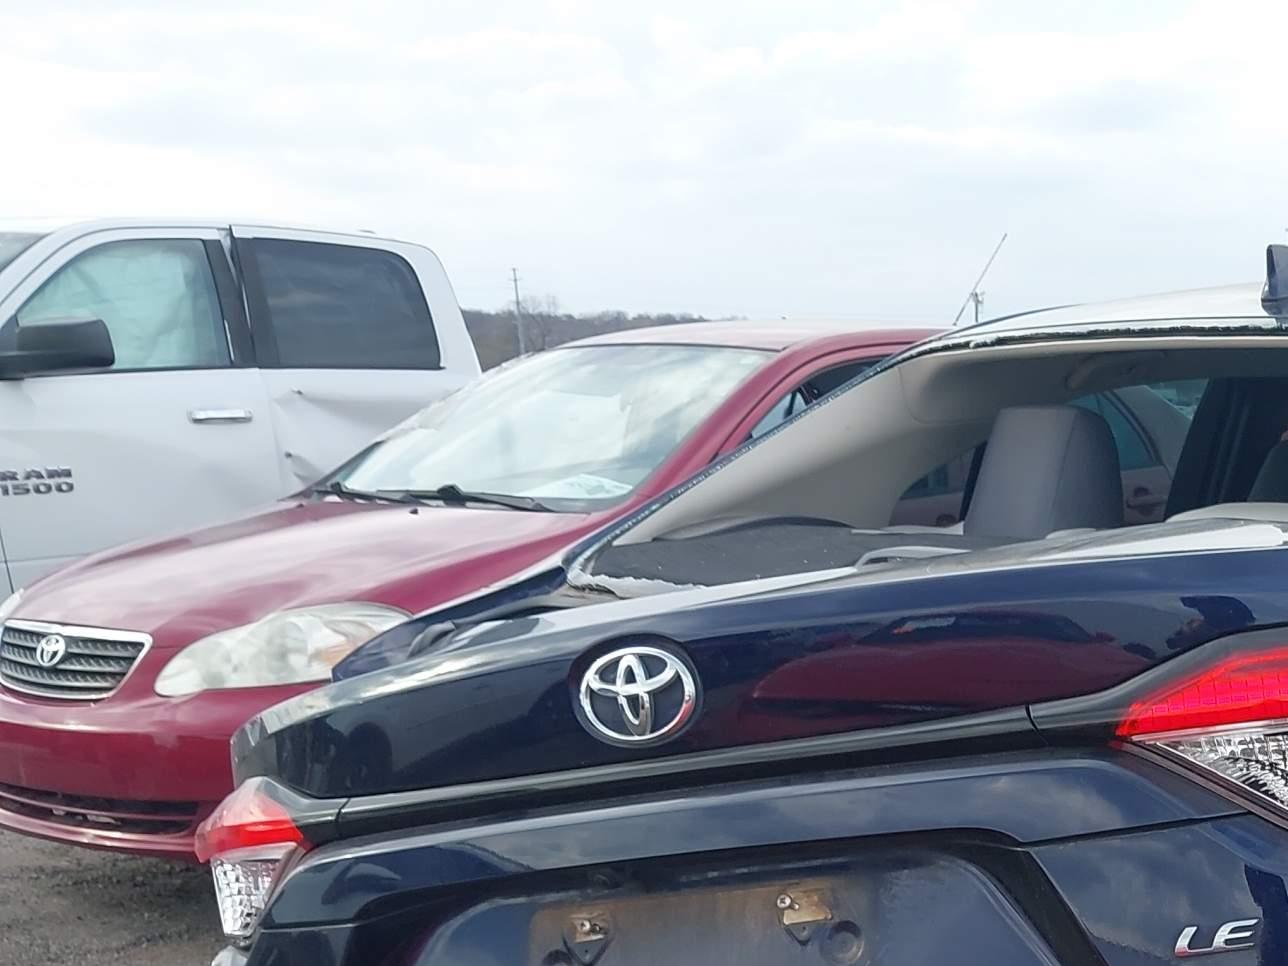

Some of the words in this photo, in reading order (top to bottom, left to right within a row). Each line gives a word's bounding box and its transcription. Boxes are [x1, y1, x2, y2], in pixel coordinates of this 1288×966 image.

[0, 467, 72, 481] RAM
[0, 481, 74, 496] 1500
[1175, 919, 1260, 957] LE
